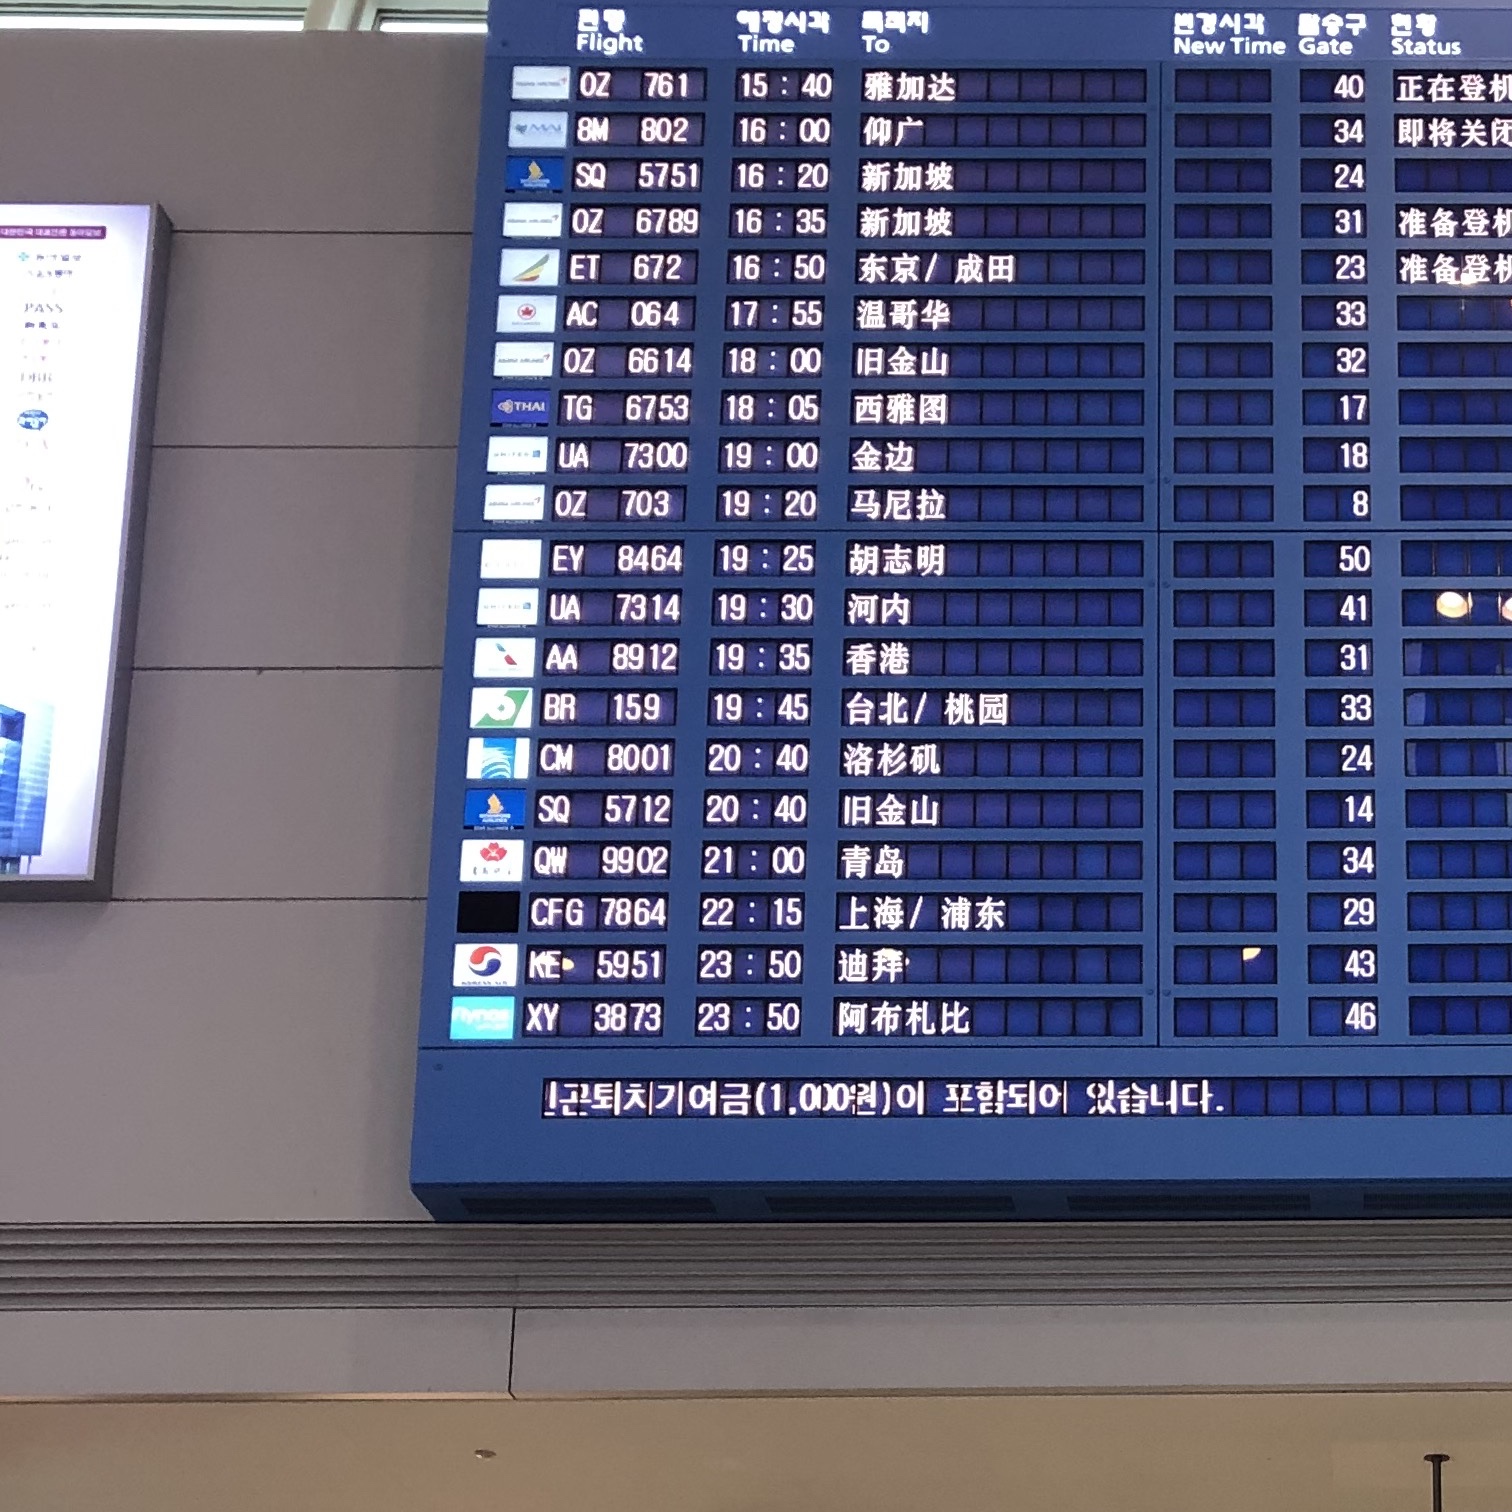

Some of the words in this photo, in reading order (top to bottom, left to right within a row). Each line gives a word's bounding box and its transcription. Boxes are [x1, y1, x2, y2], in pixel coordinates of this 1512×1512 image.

[576, 32, 644, 56] Flight
[738, 34, 795, 53] Time
[861, 34, 890, 53] To
[1174, 33, 1226, 55] New
[1229, 33, 1287, 55] Time
[1298, 33, 1356, 56] Gate
[1391, 33, 1462, 56] Status
[579, 71, 611, 97] OZ
[645, 72, 688, 98] 761
[864, 71, 956, 102] 雅加达
[1334, 74, 1364, 99] 40
[576, 116, 609, 142] 8M
[640, 117, 689, 143] 802
[863, 115, 924, 147] 仰广
[1334, 119, 1364, 144] 34
[575, 162, 607, 189] SQ
[638, 162, 698, 188] 5751
[861, 161, 954, 192] 新加坡
[1334, 163, 1365, 189] 24
[572, 208, 604, 234] OZ
[636, 208, 699, 234] 6789
[860, 206, 953, 238] 新加坡
[1335, 209, 1362, 234] 31
[569, 254, 601, 280] ET
[633, 254, 682, 280] 672
[1335, 254, 1366, 280] 23
[566, 300, 599, 327] AC
[630, 300, 680, 327] 064
[856, 298, 950, 331] 温哥华
[1336, 300, 1366, 327] 33
[563, 347, 596, 374] OZ
[628, 347, 692, 374] 6614
[856, 345, 948, 377] 旧金山
[1336, 347, 1367, 373] 32
[513, 401, 546, 412] THAI
[563, 394, 593, 421] TG
[625, 394, 689, 421] 6753
[854, 392, 948, 425] 西雅图
[1340, 394, 1367, 421] 17
[558, 442, 589, 469] UA
[624, 441, 688, 469] 7300
[852, 440, 914, 472] 金边
[1340, 442, 1368, 469] 18
[554, 490, 587, 517] OZ
[622, 490, 670, 517] 703
[850, 488, 946, 521] 马尼拉
[1352, 490, 1369, 517] 8
[552, 545, 585, 572] EY
[617, 545, 683, 572] 8464
[849, 543, 945, 577] 胡志明
[1339, 545, 1371, 572] 50
[549, 593, 581, 621] UA
[616, 593, 680, 621] 7314
[847, 592, 910, 626] 河内
[1340, 594, 1367, 621] 41
[545, 643, 578, 671] AA
[612, 643, 678, 671] 8912
[846, 641, 910, 676] 香港
[1340, 644, 1368, 671] 31
[543, 693, 576, 721] BR
[613, 693, 661, 721] 159
[1340, 694, 1372, 721] 33
[540, 743, 574, 772] CM
[607, 743, 670, 772] 8001
[843, 742, 941, 777] 洛杉矶
[1341, 744, 1373, 772] 24
[538, 795, 571, 824] SQ
[604, 794, 671, 823] 5712
[843, 793, 939, 827] 旧金山
[1345, 795, 1374, 823] 14
[533, 846, 568, 876] QW
[602, 846, 669, 874] 9902
[841, 844, 904, 879] 青岛
[1342, 846, 1375, 874] 34
[530, 897, 585, 926] CFG
[600, 897, 667, 926] 7864
[1343, 897, 1375, 926] 29
[596, 950, 660, 979] 5951
[1344, 949, 1376, 978] 43
[526, 1002, 559, 1032] XY
[594, 1002, 662, 1032] 3873
[838, 1000, 970, 1036] 阿布札比
[1344, 1002, 1377, 1030] 46
[1085, 1079, 1225, 1116] 있습니다.
